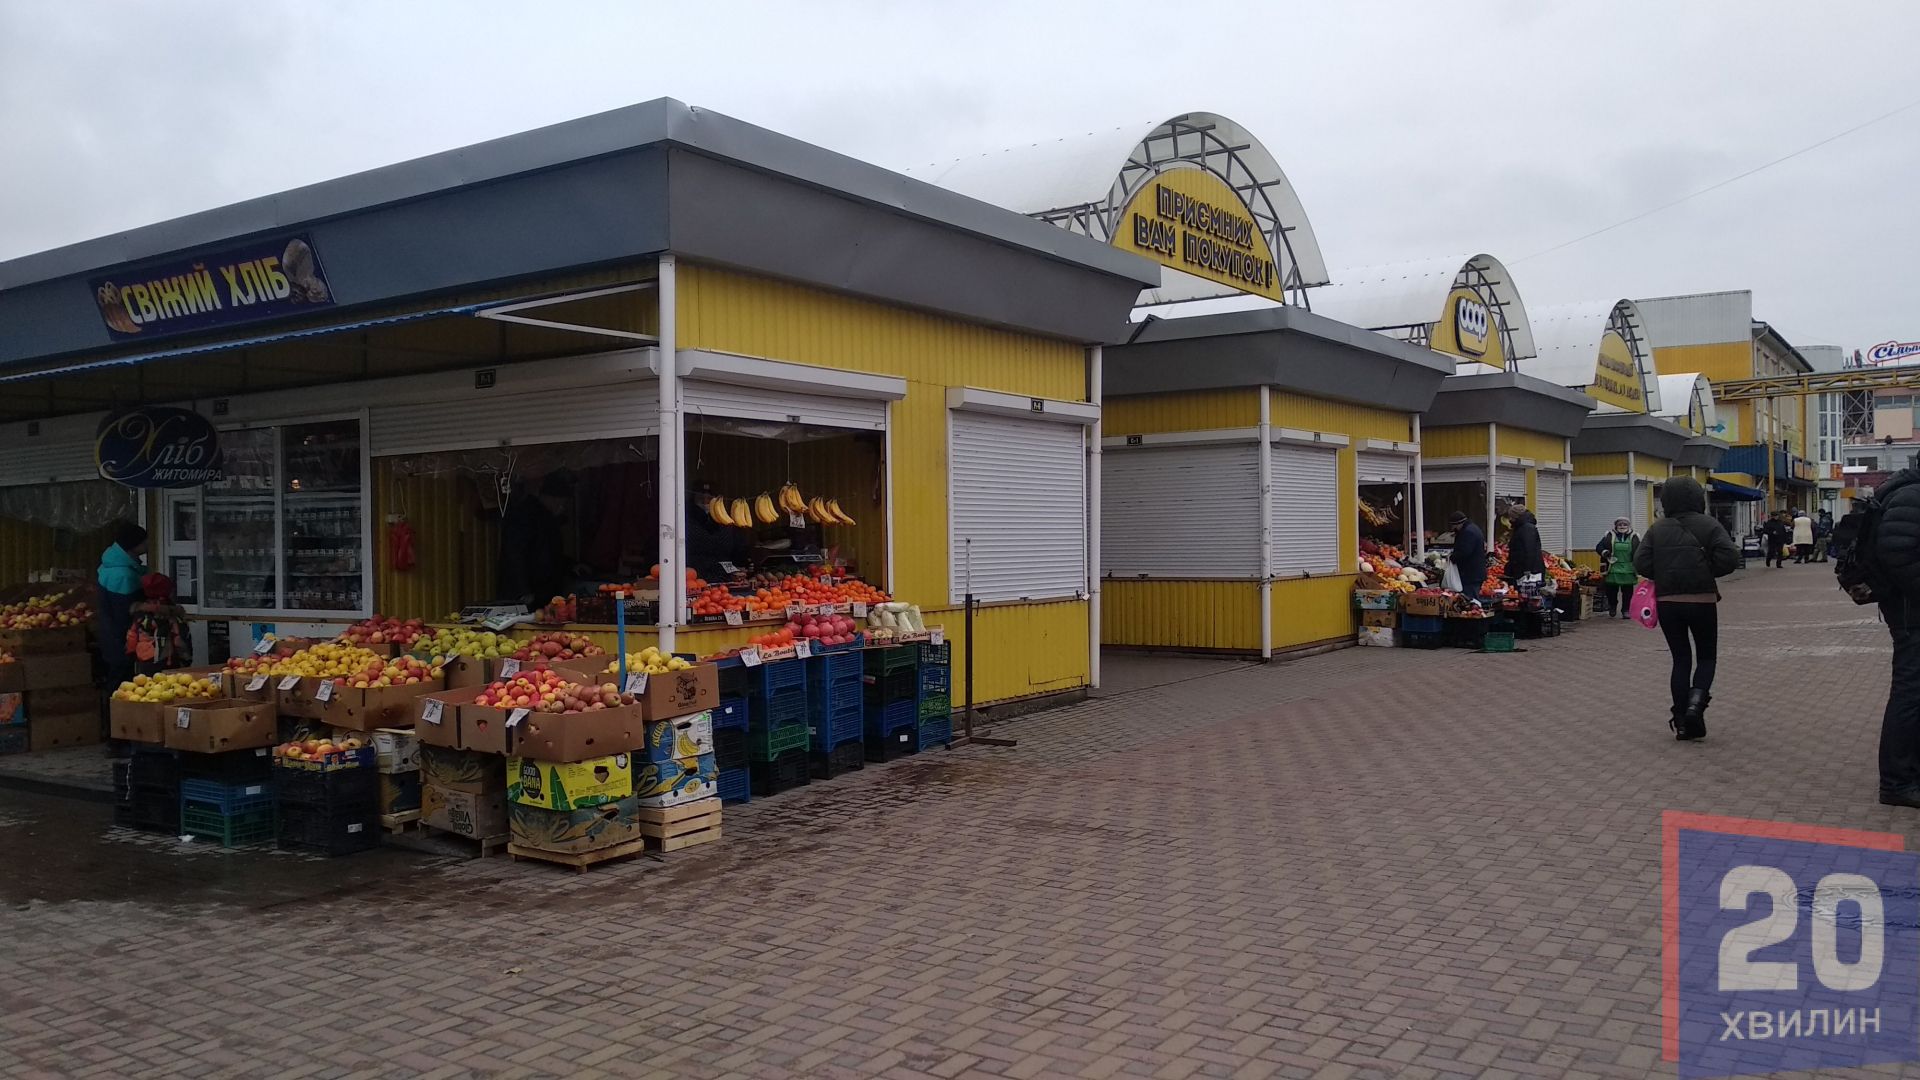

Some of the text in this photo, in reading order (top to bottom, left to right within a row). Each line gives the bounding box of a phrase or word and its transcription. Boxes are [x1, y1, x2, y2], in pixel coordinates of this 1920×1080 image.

[1134, 213, 1176, 256] ВАМ
[1156, 183, 1253, 248] ПРИЄМНИХ
[120, 256, 290, 324] СВІЖИЙ ХЛІБ
[152, 468, 222, 481] ЖИТОМИРА
